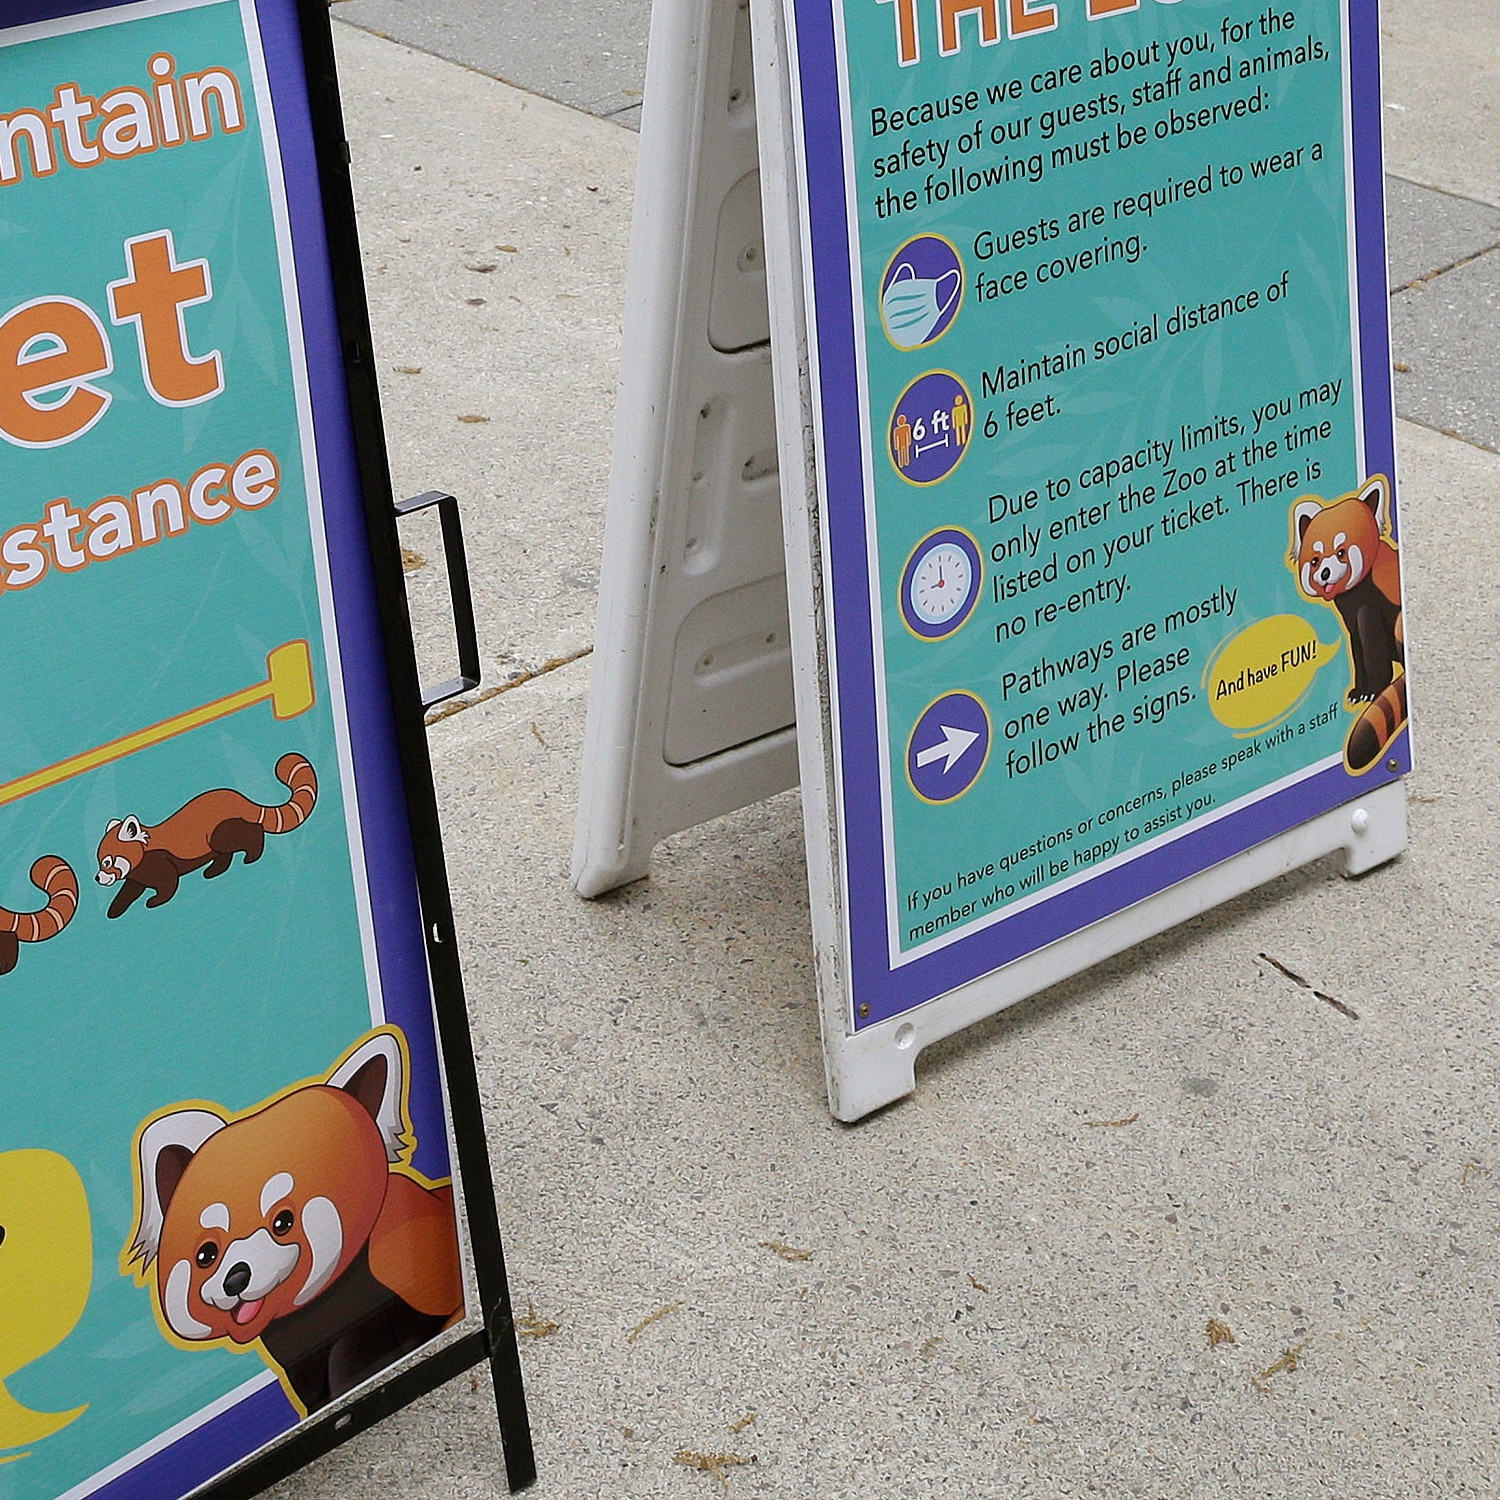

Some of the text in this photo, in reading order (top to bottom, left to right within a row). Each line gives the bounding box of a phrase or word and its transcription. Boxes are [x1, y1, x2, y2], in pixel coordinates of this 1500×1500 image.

[870, 6, 1295, 136] Because we care about you, for the
[873, 34, 1329, 178] safety of our guests, staff and animals,
[874, 84, 1269, 218] the following must be observed:
[973, 142, 1322, 260] Guests are required to wear a
[974, 235, 1147, 302] face covering.
[981, 269, 1289, 398] Maintain social distance of
[912, 409, 949, 440] 6 ft
[983, 394, 1060, 438] 6 feet.
[1002, 583, 1237, 701] Pathways are mostly
[1004, 647, 1189, 739] one way. Please
[1215, 639, 1316, 700] And have FUN!
[1005, 685, 1196, 779] follow the signs.
[907, 701, 1337, 911] If you have questions or concerns, please speak with a staff
[909, 793, 1215, 941] member who will be happy to assist you.
